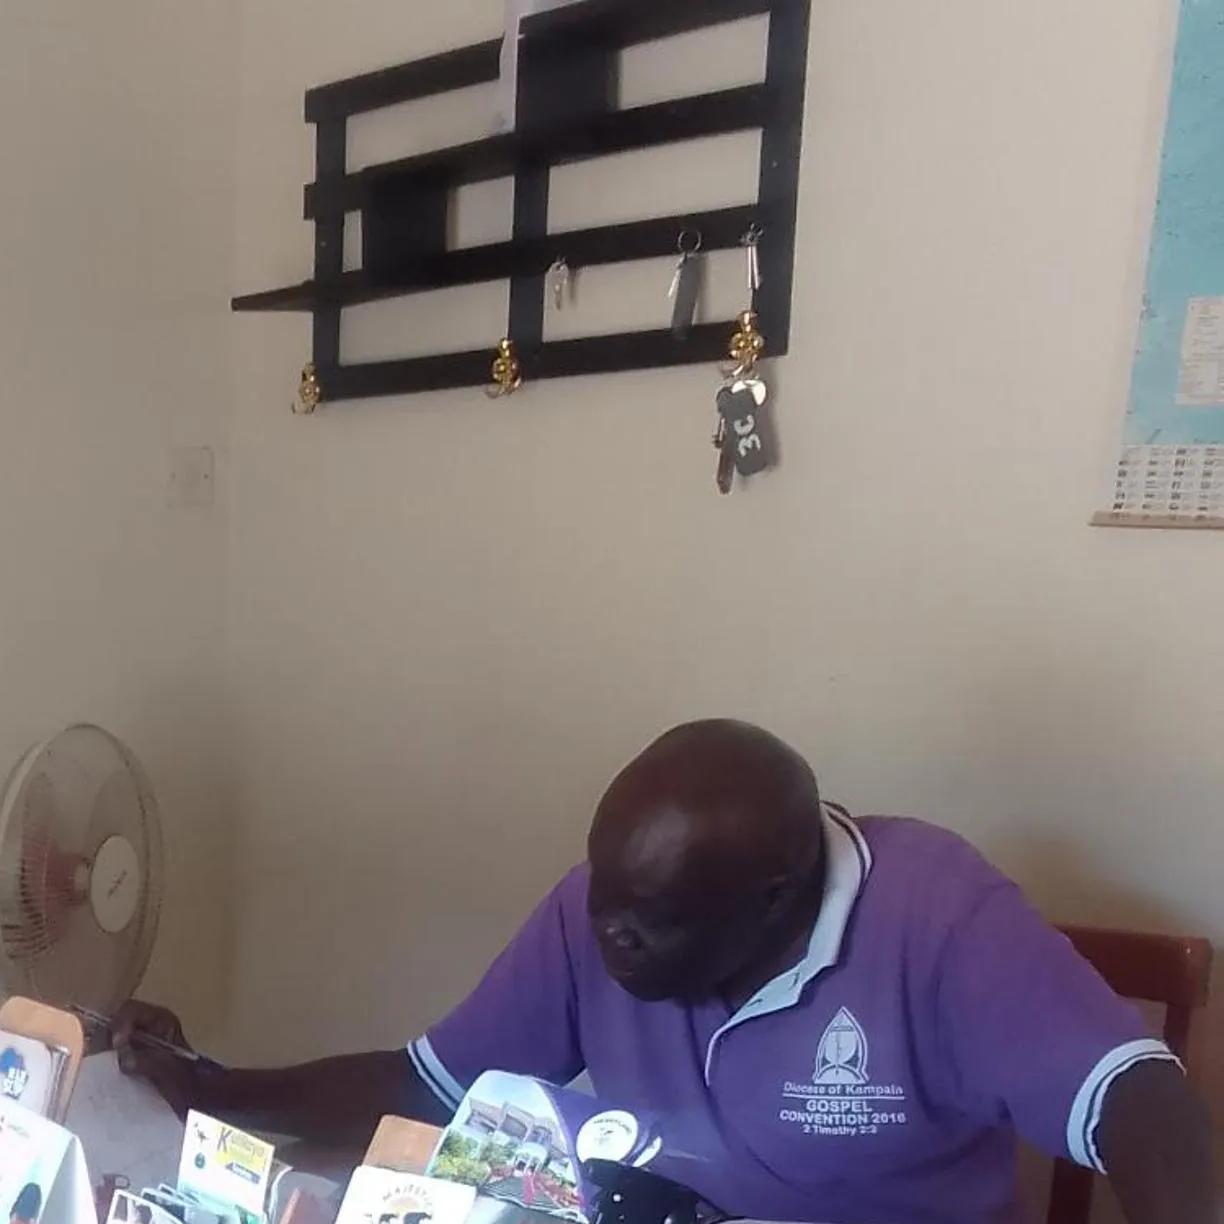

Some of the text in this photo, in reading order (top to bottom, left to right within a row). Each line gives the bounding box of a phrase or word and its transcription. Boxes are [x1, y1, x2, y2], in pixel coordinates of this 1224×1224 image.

[784, 1081, 904, 1098] Diocese of Kampala
[806, 1100, 873, 1113] GOSPEL
[779, 1109, 868, 1125] CONVENTION
[812, 1125, 856, 1136] Timothy
